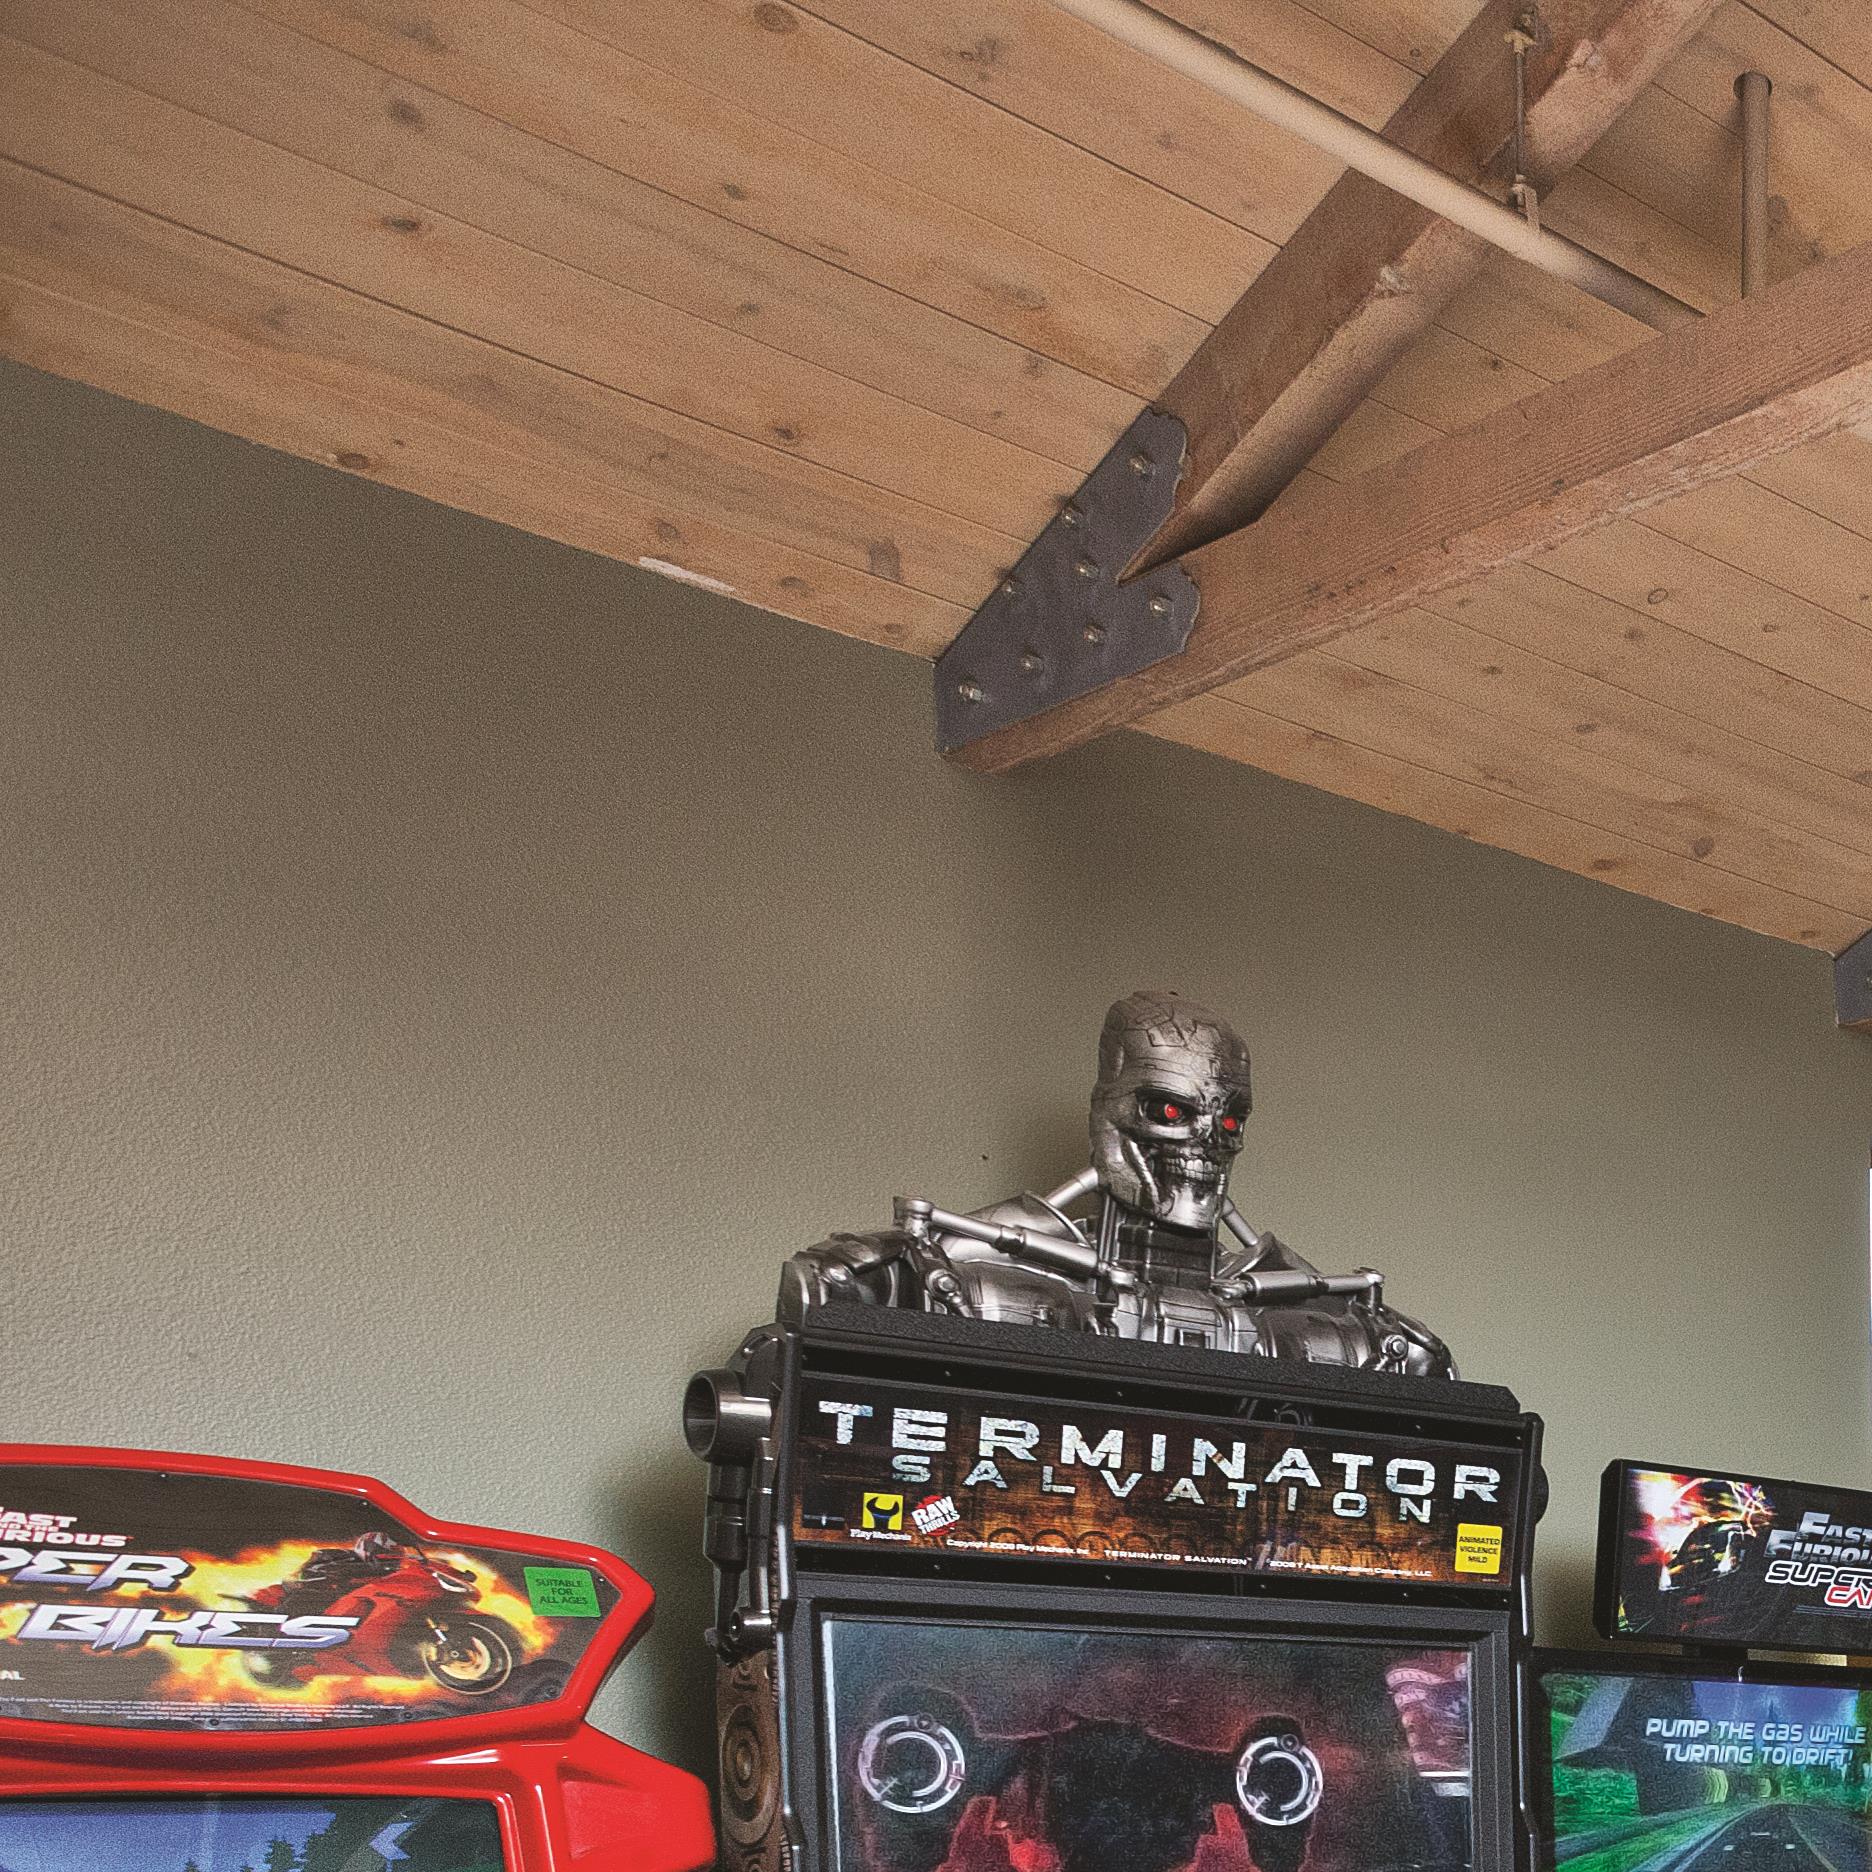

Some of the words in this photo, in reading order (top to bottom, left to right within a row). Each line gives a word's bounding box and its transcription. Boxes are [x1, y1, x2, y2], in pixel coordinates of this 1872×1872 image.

[818, 1400, 1501, 1503] TERMINATOR
[892, 1454, 1432, 1524] SALVATION
[0, 1507, 77, 1528] AST
[911, 1496, 954, 1526] RAW
[0, 1529, 126, 1547] RIOUS
[1458, 1535, 1501, 1546] ANIMATED
[1104, 1549, 1181, 1561] TERMINATOR
[1459, 1545, 1498, 1555] VIOLENCE
[1468, 1555, 1488, 1565] MILD
[536, 1578, 583, 1588] SUITABLE
[551, 1587, 574, 1596] FOR
[540, 1595, 560, 1604] ALL
[562, 1596, 588, 1605] AGES
[16, 1604, 361, 1652] BIKES
[1646, 1718, 1710, 1737] PUMP
[1717, 1720, 1755, 1740] THE
[1809, 1725, 1867, 1744] WHILE
[1662, 1743, 1754, 1764] TURNING
[1761, 1746, 1786, 1764] TO
